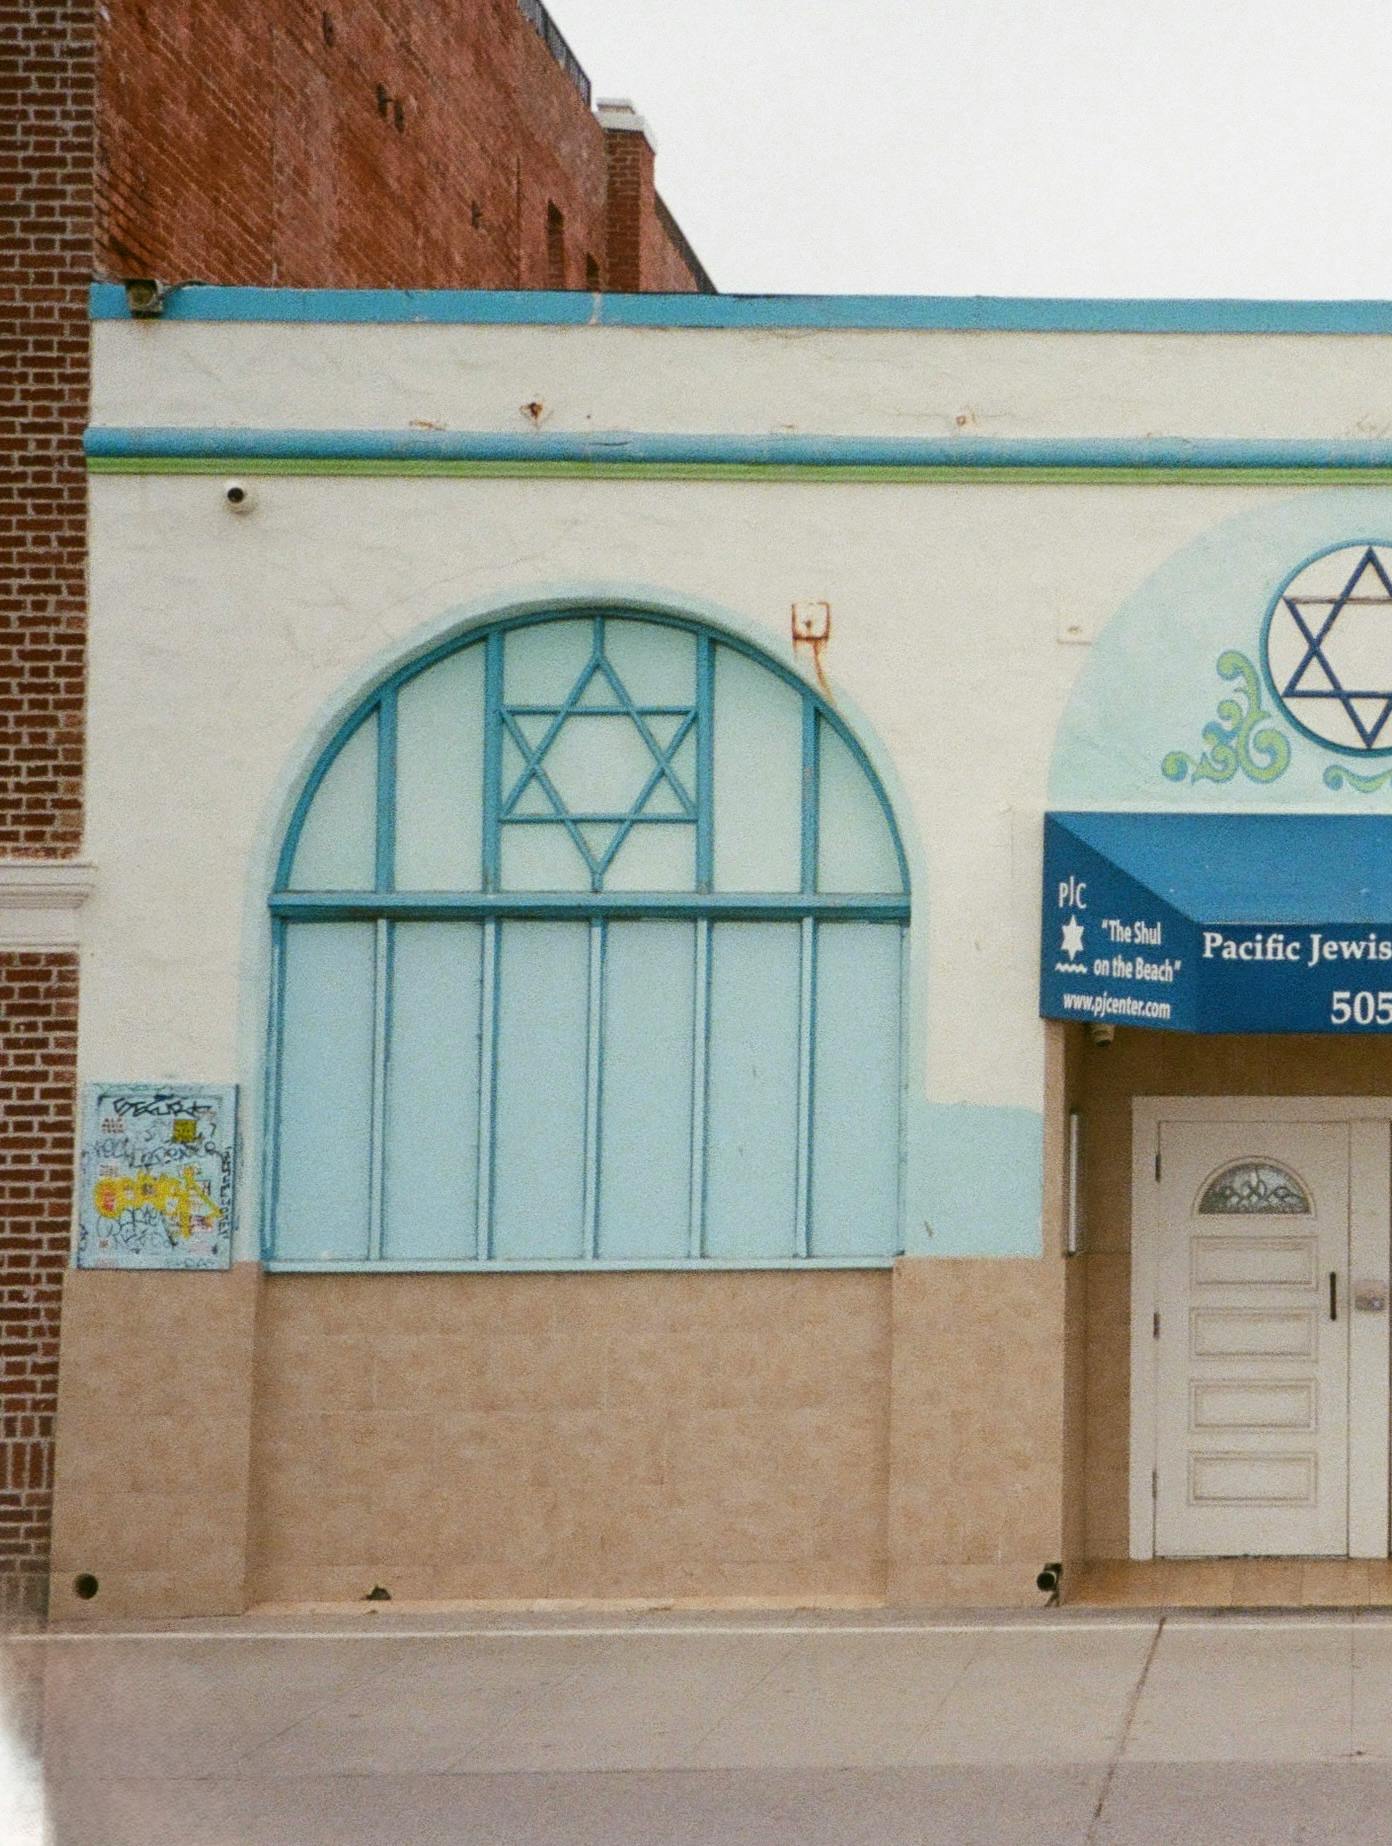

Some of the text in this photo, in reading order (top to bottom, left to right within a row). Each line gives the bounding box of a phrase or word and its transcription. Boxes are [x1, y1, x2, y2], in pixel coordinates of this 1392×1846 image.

[1134, 921, 1161, 945] Shul
[1202, 931, 1300, 961] Pacific
[1093, 959, 1110, 976] on
[1112, 955, 1133, 979] the
[1063, 991, 1171, 1020] www.pjcenter.com
